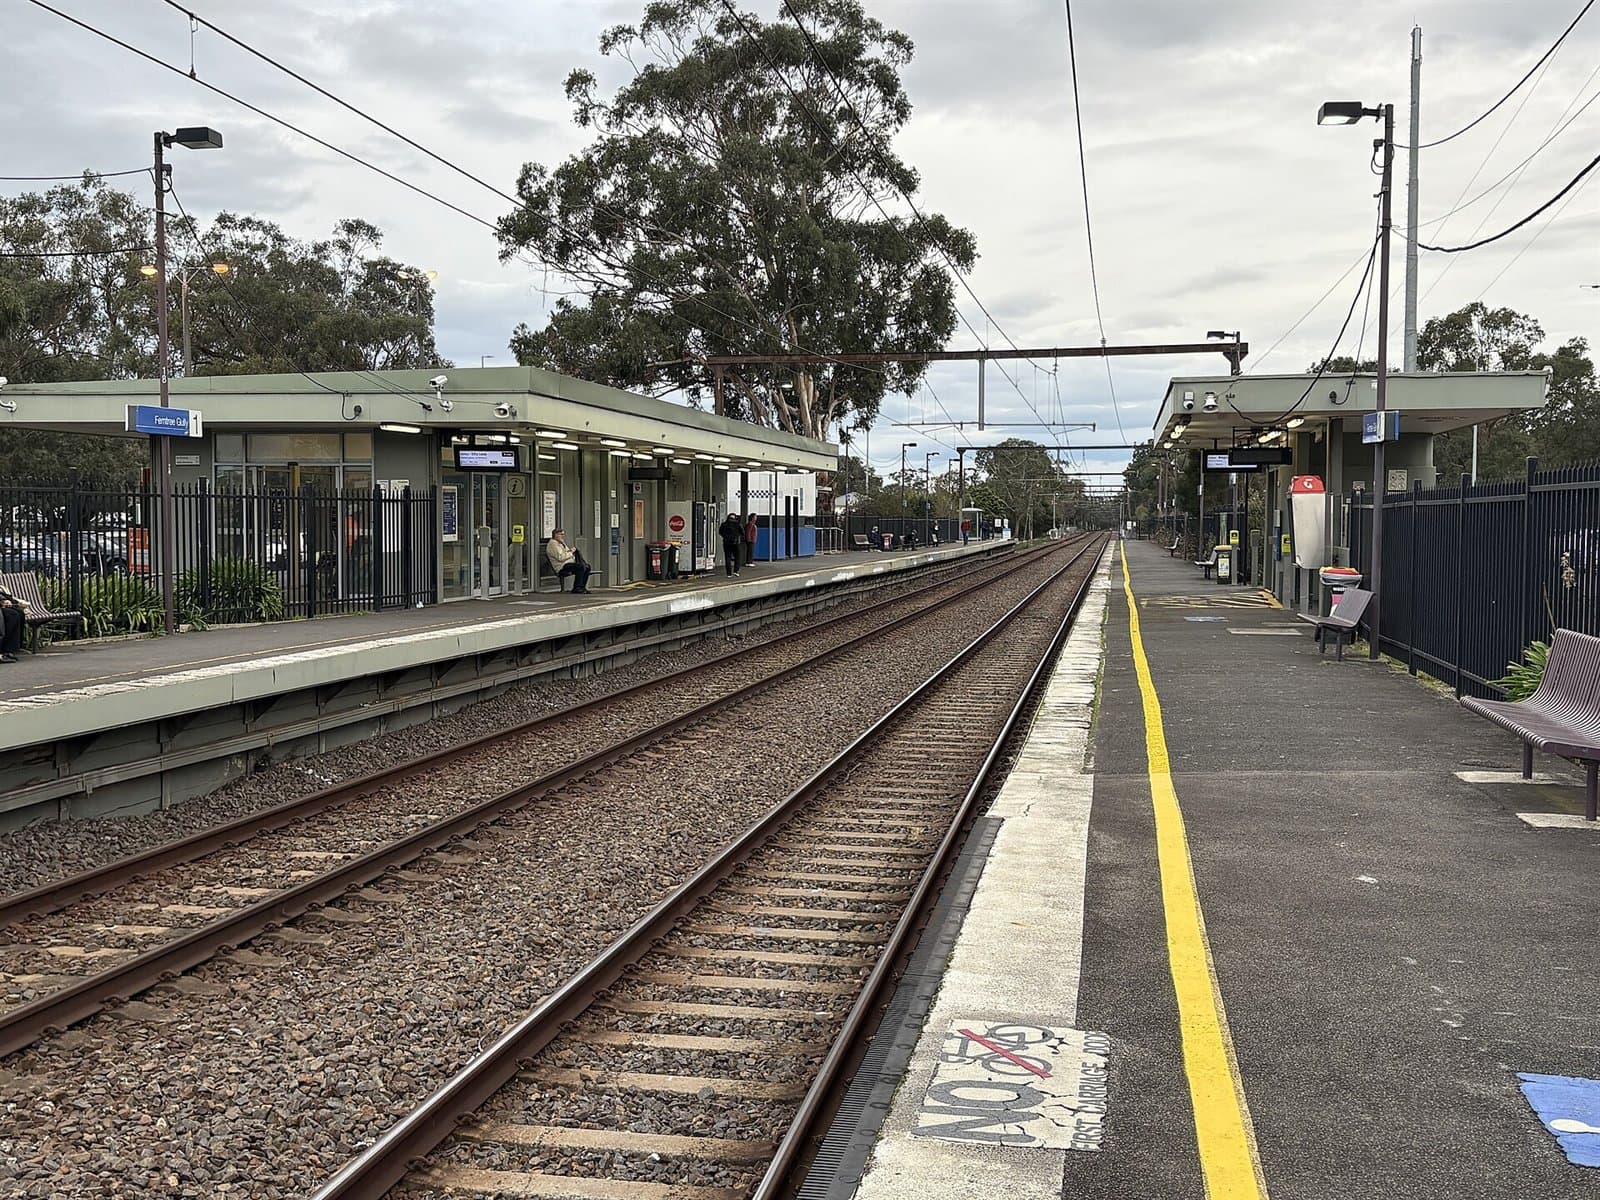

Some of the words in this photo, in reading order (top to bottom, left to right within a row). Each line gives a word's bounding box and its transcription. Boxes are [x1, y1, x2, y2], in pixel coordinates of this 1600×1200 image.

[193, 414, 198, 435] 1
[1078, 1062, 1107, 1114] CARRIAGE
[911, 1080, 1046, 1143] NO
[1071, 1118, 1100, 1150] FIRST
